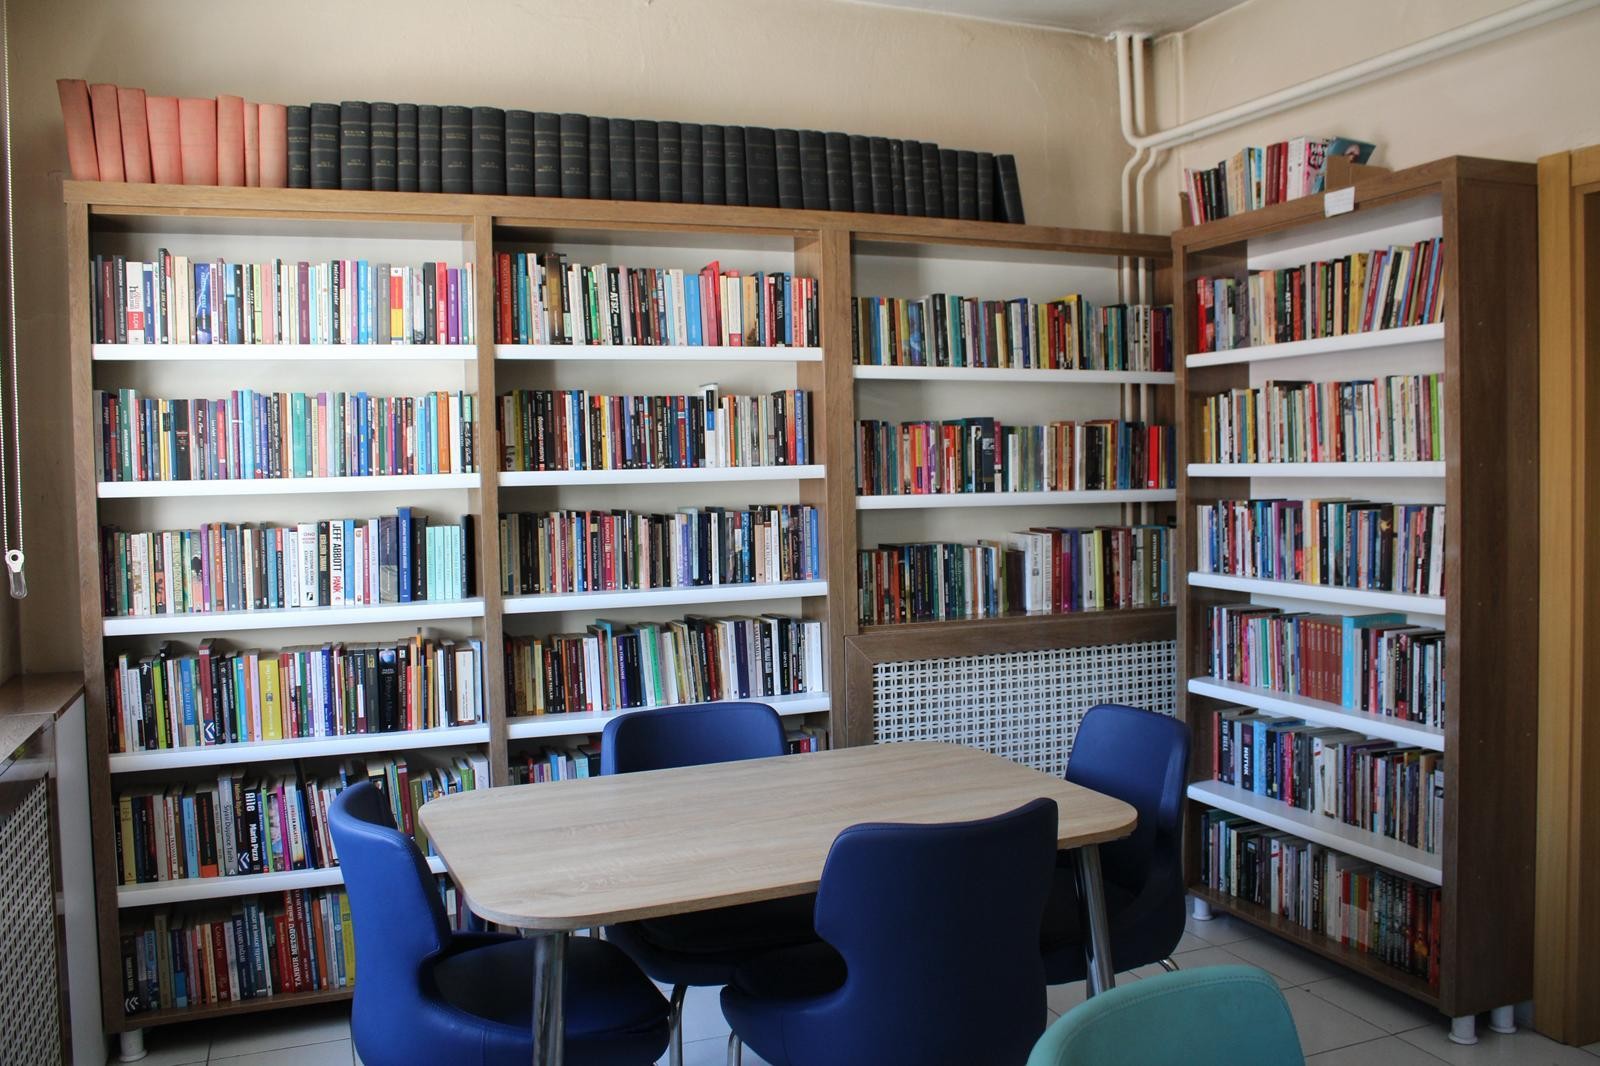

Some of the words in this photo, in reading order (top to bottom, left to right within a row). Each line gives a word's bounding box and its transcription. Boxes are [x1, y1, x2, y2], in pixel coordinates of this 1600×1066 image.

[609, 291, 620, 314] ATSIZ
[332, 524, 342, 542] JEFF
[332, 543, 342, 572] ABBOTT
[333, 575, 343, 593] PANİK
[244, 792, 256, 812] Aile
[223, 804, 231, 822] Siyasi
[249, 823, 258, 843] Mario
[251, 844, 259, 861] Puzo
[288, 923, 298, 955] METODU
[292, 957, 301, 987] TANBUR
